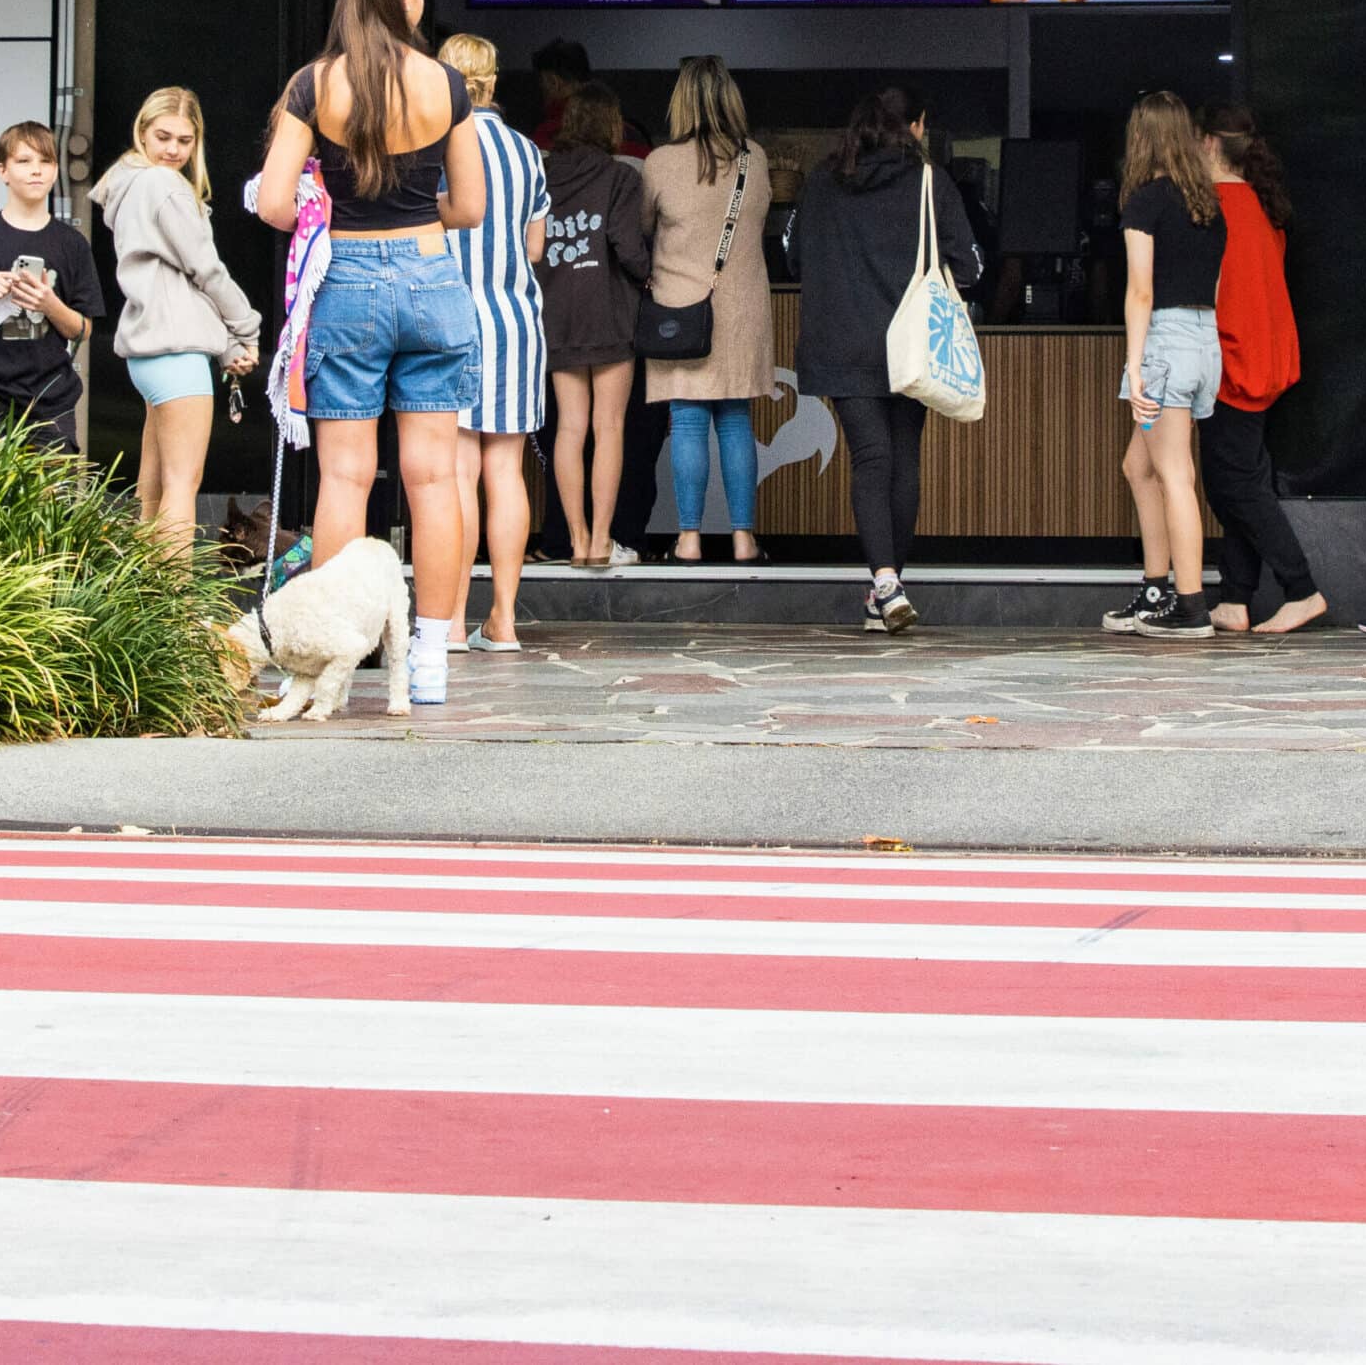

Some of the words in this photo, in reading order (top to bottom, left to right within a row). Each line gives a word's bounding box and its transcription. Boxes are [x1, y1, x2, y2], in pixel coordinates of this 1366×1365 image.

[729, 189, 742, 220] MIMCO
[546, 209, 603, 239] hite
[547, 236, 590, 267] fox
[718, 229, 732, 260] MIMCO
